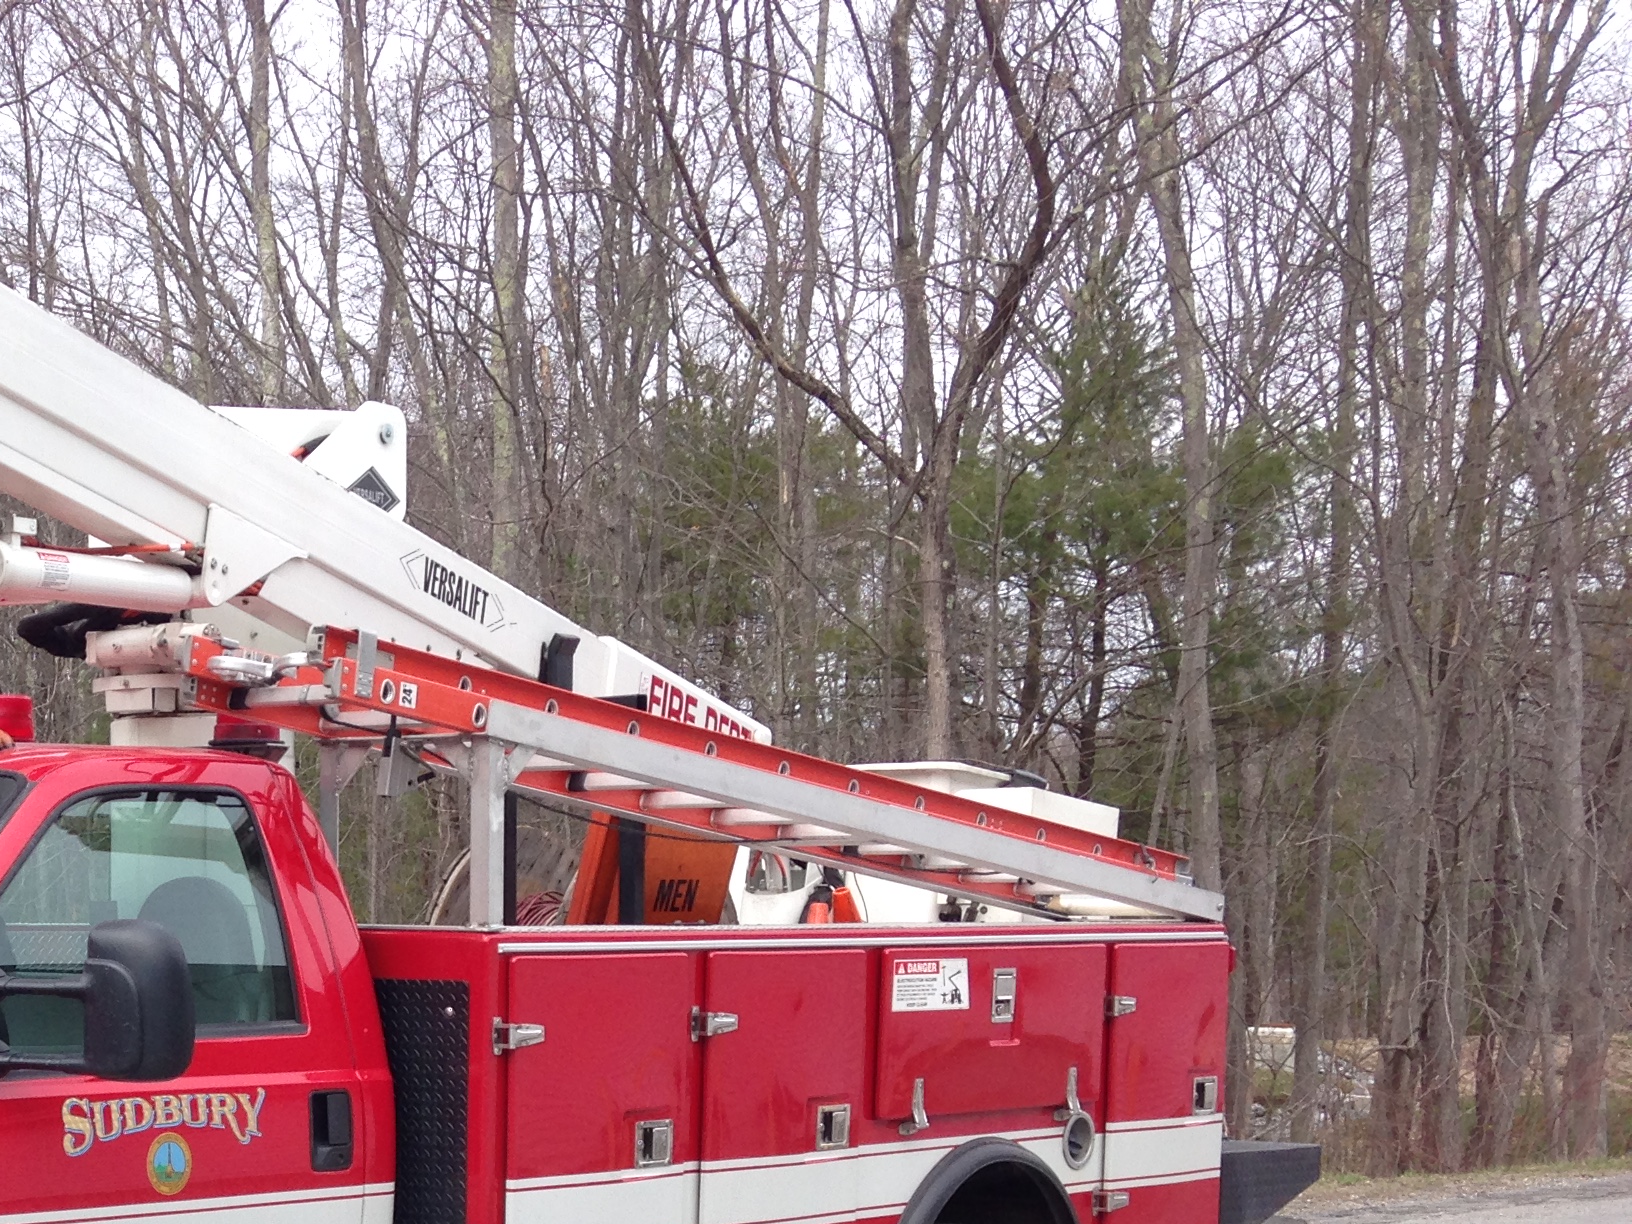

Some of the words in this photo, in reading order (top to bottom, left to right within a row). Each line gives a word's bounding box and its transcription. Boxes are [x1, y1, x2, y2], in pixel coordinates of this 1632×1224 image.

[423, 556, 489, 625] VERSALIFT
[648, 674, 698, 723] FIRE
[653, 879, 699, 912] MEN
[907, 962, 937, 974] DANGER
[62, 1087, 266, 1157] SUDBURY
